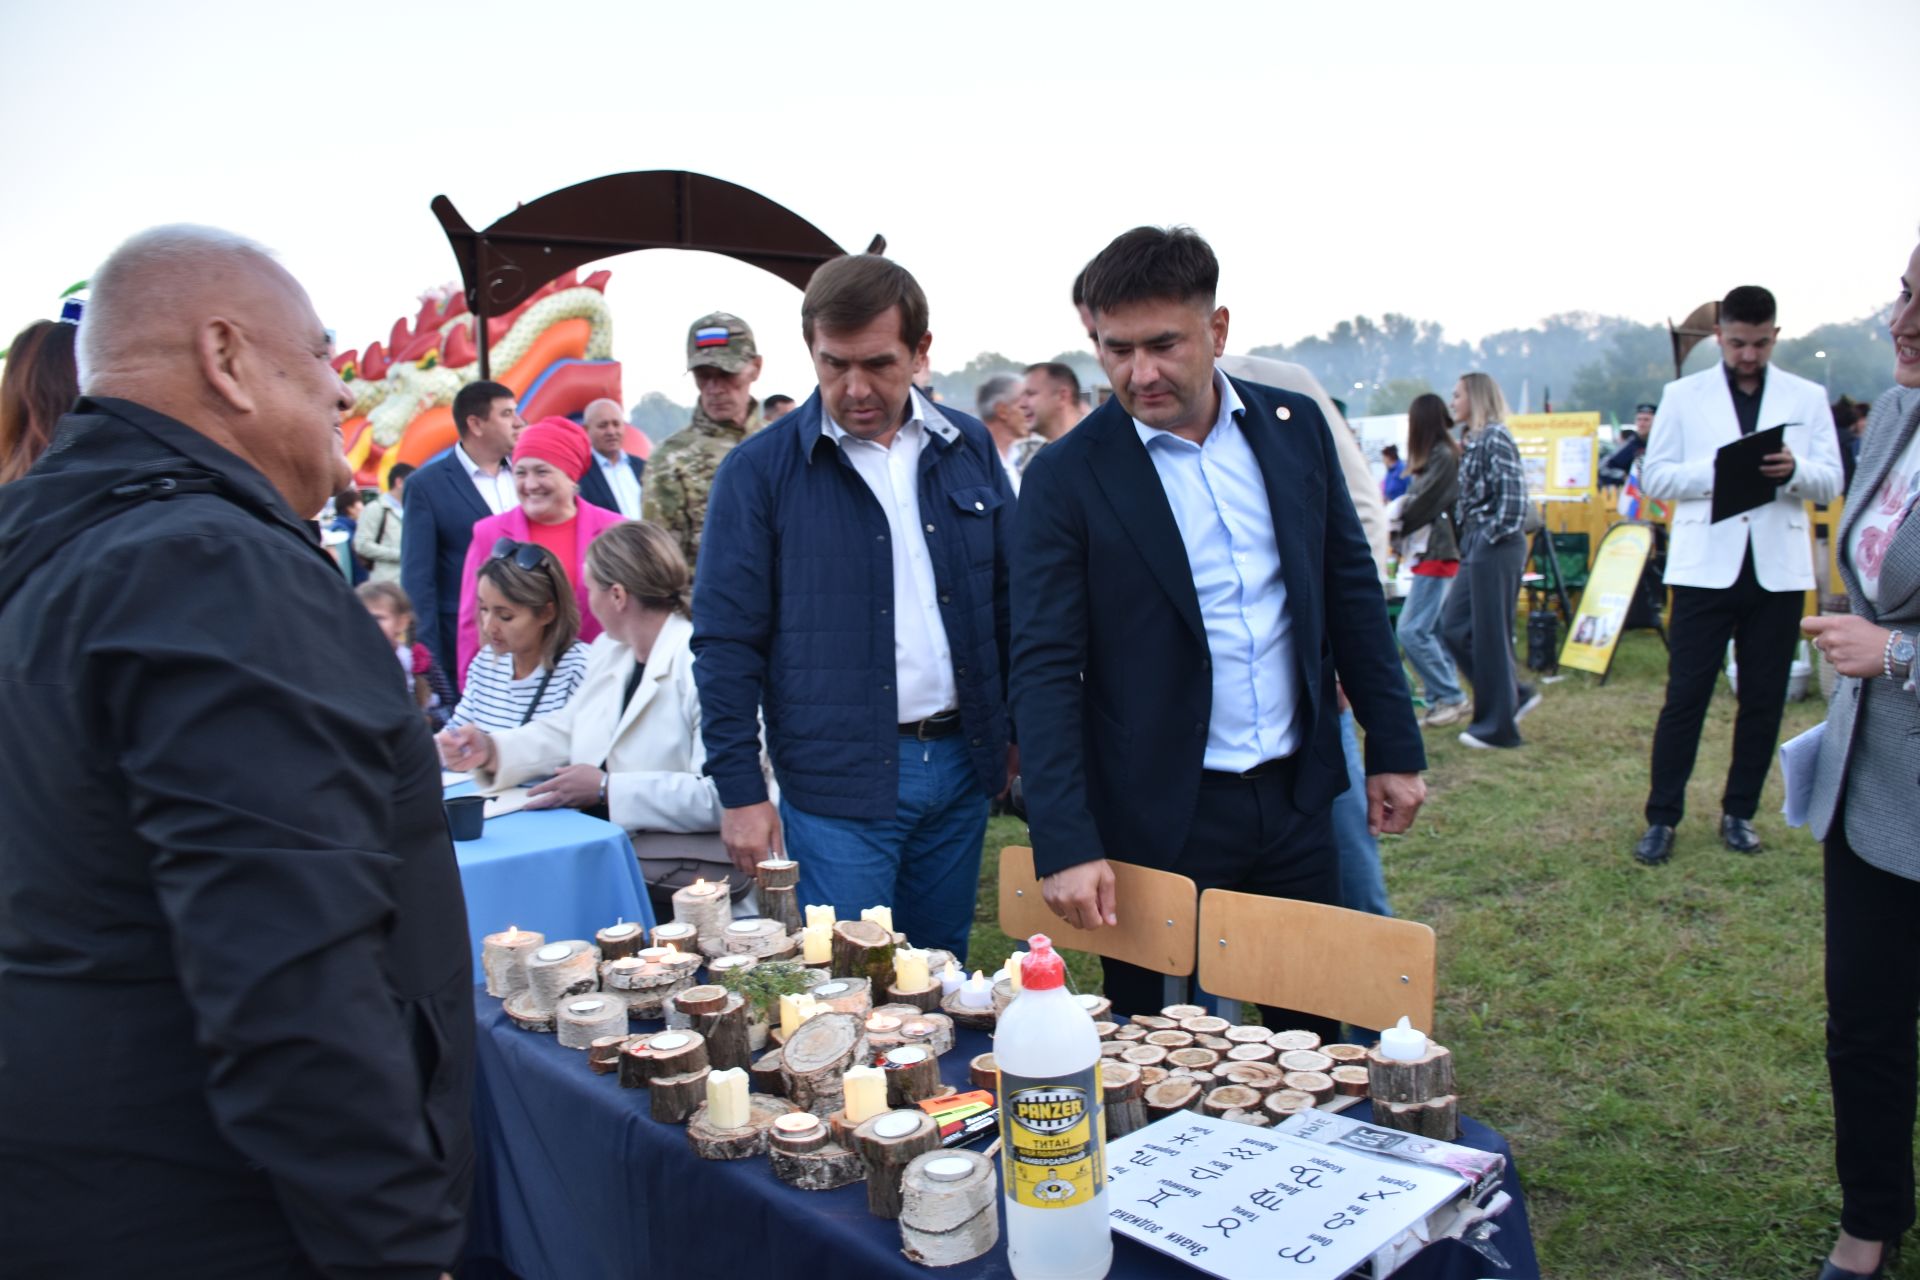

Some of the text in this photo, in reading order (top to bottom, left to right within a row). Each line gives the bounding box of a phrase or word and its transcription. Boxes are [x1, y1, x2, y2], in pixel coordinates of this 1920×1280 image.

[1017, 1099, 1082, 1120] PANZER
[1032, 1138, 1071, 1149] ТИТАН
[1019, 1151, 1086, 1166] УНИВЕРСАЛЬНЫЙ
[1208, 1160, 1233, 1172] Весы
[1308, 1157, 1345, 1174] Козерог
[1158, 1179, 1201, 1197] Близнецы
[1275, 1182, 1303, 1196] Дева
[1376, 1175, 1418, 1191] Стрелец
[1232, 1206, 1259, 1223] Телец
[1347, 1204, 1368, 1216] Лев
[1109, 1208, 1208, 1257] Знаки зодиака
[1307, 1233, 1333, 1247] Овен
